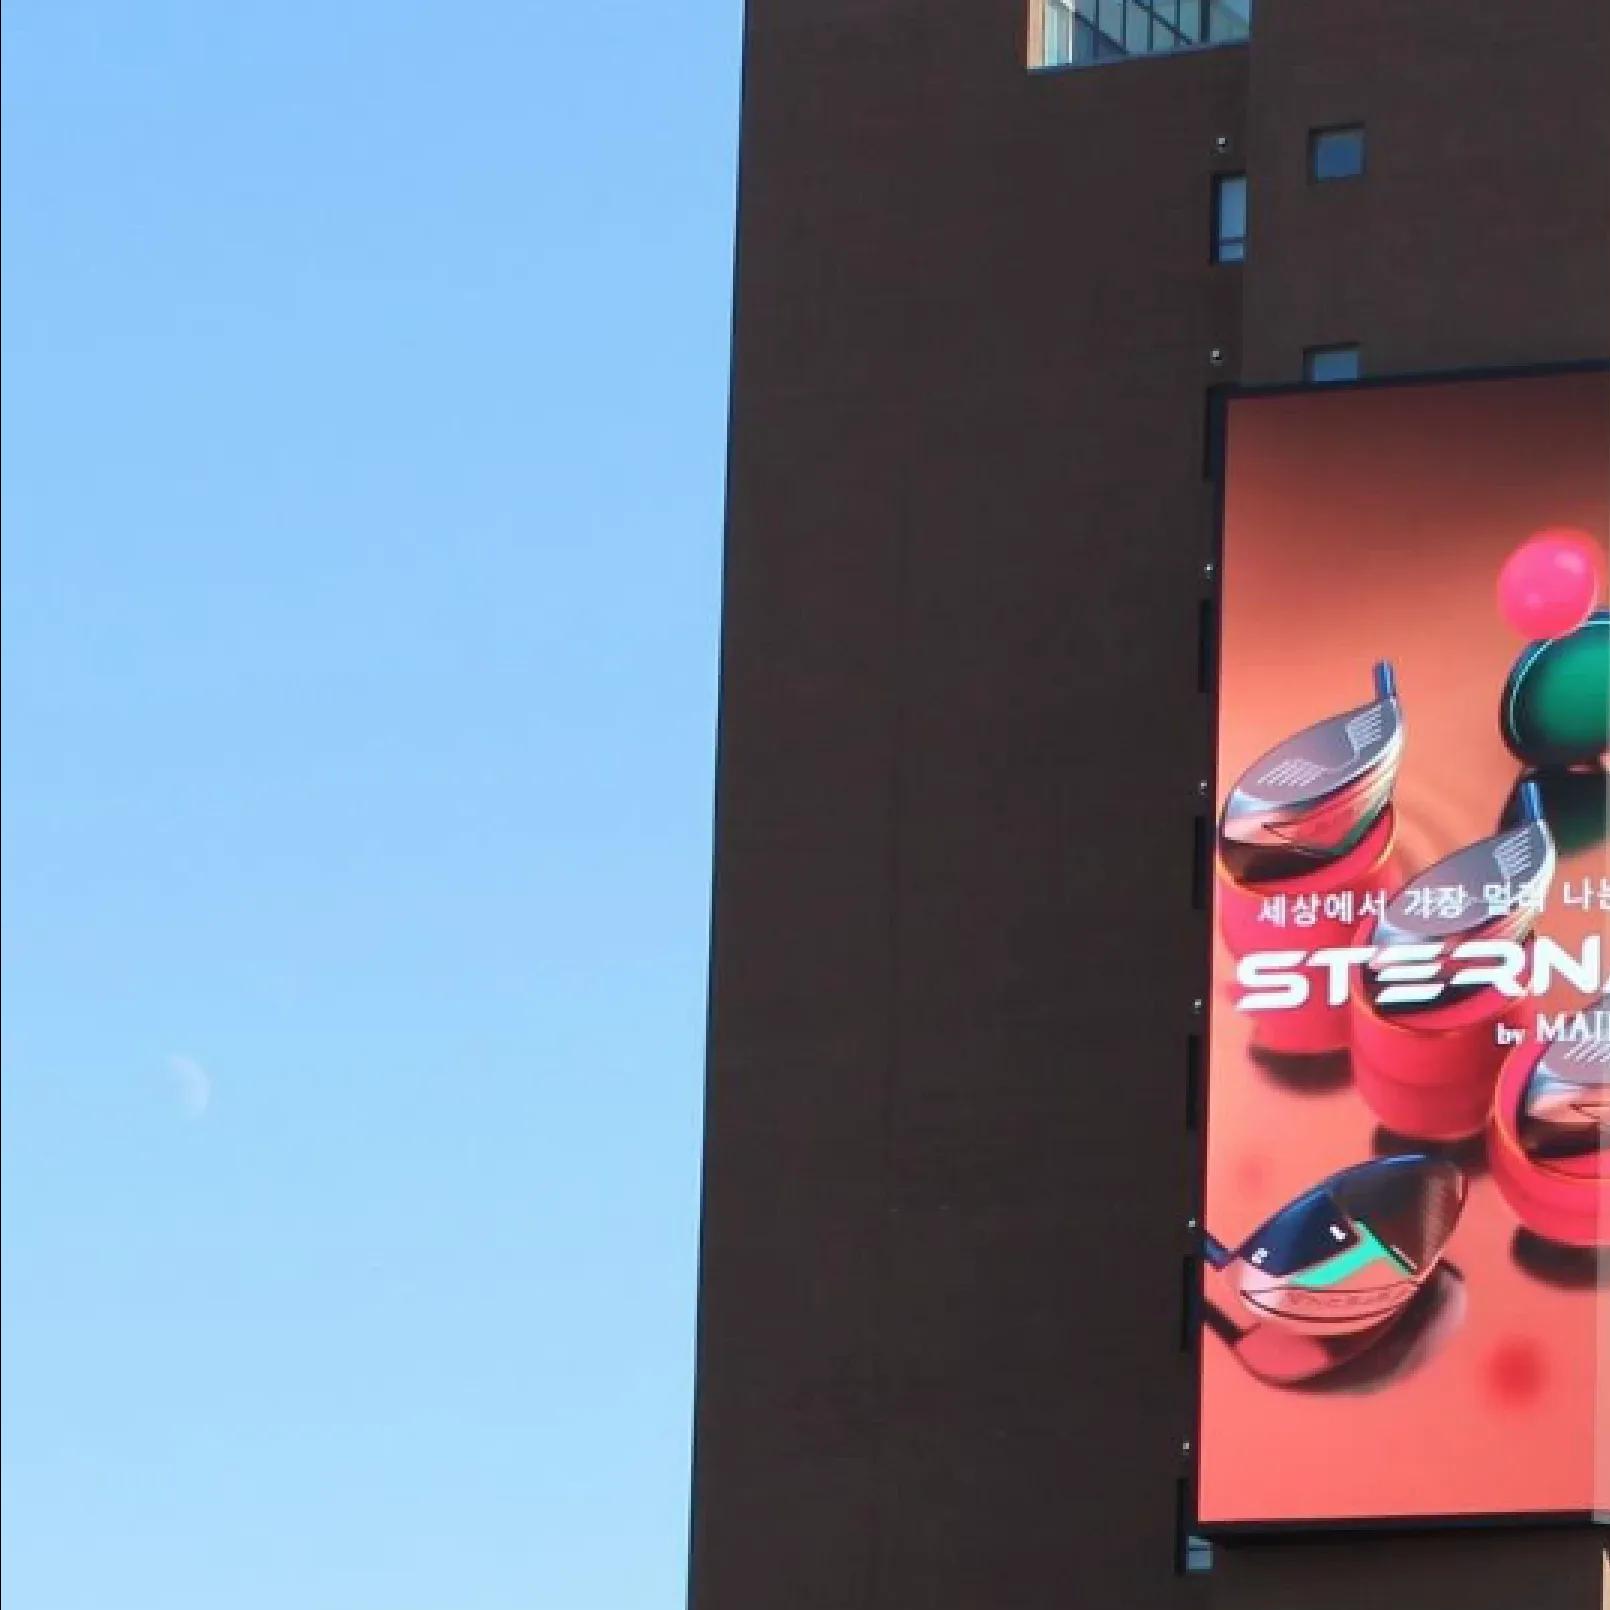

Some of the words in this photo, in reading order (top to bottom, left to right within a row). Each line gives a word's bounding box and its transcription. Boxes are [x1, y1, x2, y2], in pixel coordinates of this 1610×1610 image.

[1257, 888, 1387, 928] 세상에서
[1403, 883, 1469, 919] 가장
[1482, 879, 1546, 916] 멀리
[1496, 1022, 1526, 1046] by
